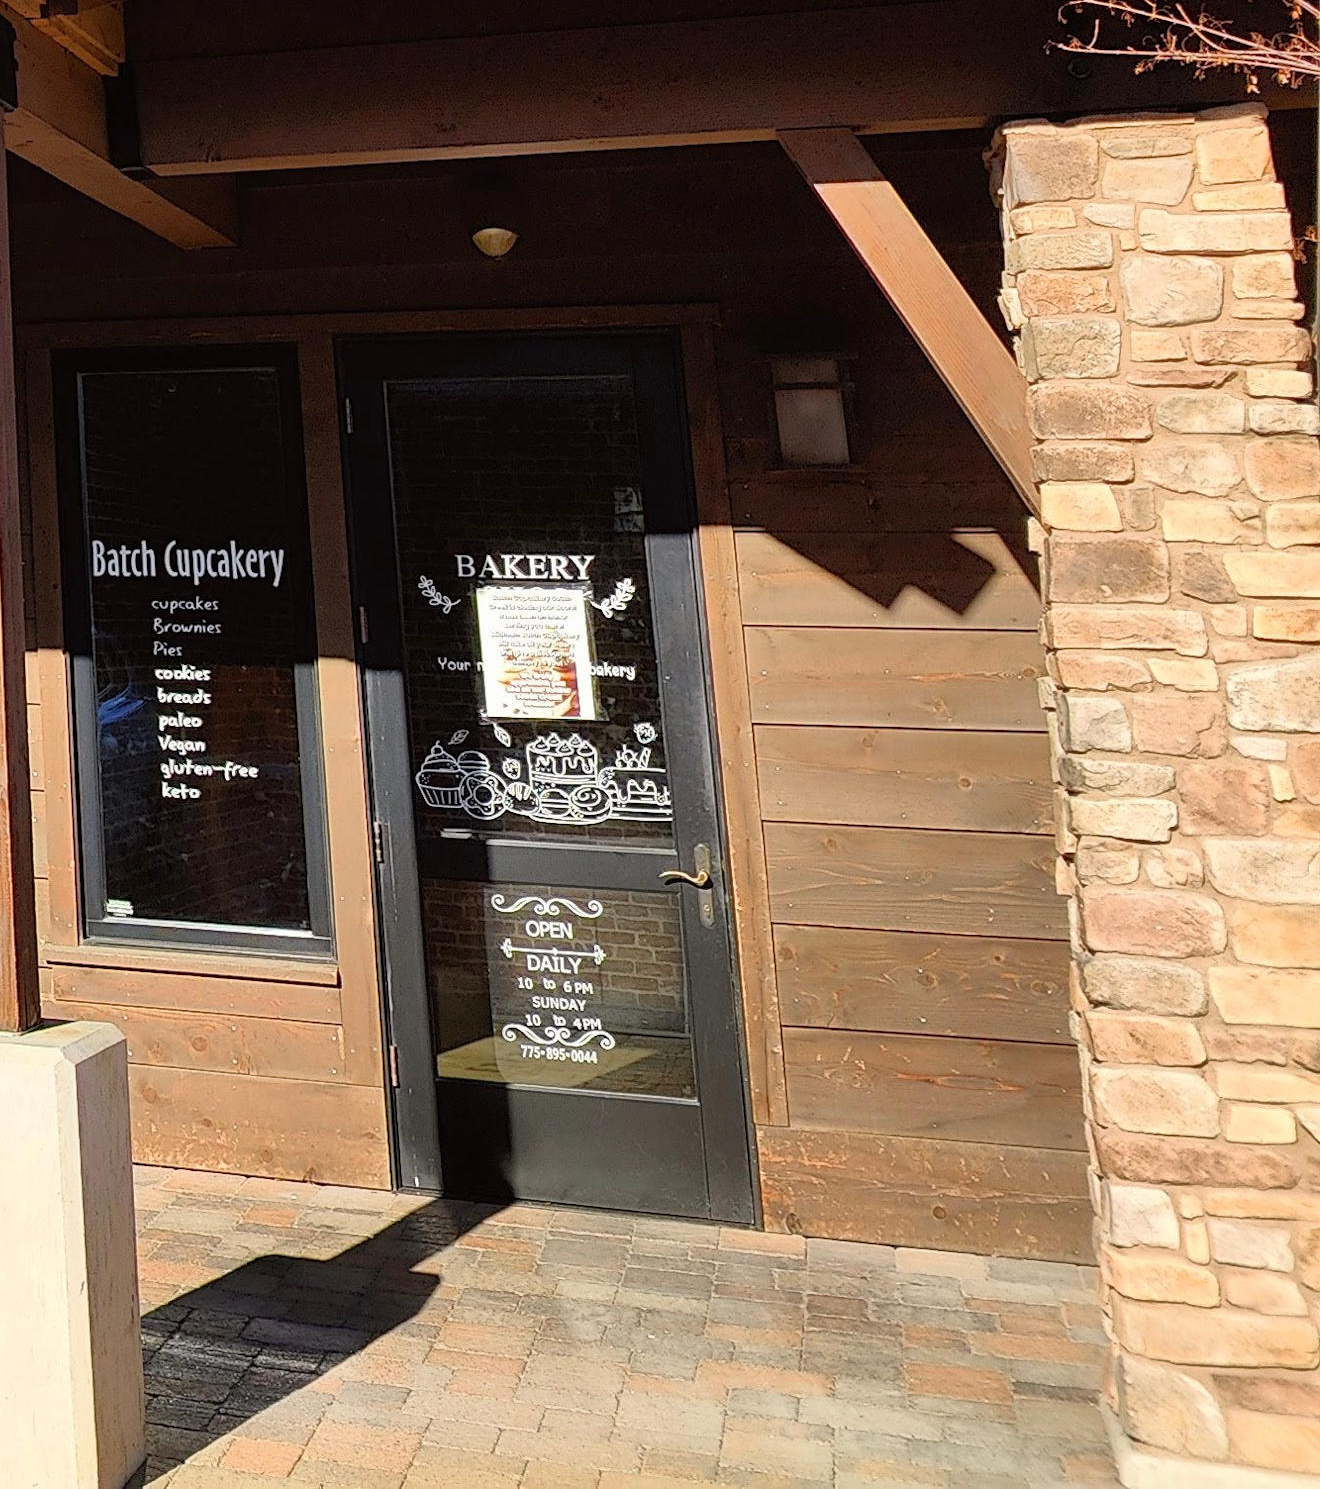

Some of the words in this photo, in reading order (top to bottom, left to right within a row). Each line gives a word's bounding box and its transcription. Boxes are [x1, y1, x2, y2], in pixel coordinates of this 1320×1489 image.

[91, 540, 157, 578] Batch
[164, 540, 285, 588] Cupcakery
[454, 554, 596, 580] BAKERY
[151, 595, 220, 615] cupcakes
[153, 617, 222, 635] Brownies
[153, 641, 183, 656] Pies
[154, 664, 211, 681] cookies
[437, 657, 472, 672] Your
[156, 686, 212, 704] breads
[157, 711, 203, 731] paleo
[157, 734, 206, 755] Vegan
[160, 758, 260, 781] gluten-free
[161, 781, 201, 800] keto
[525, 920, 574, 939] OPEN
[526, 954, 583, 974] DAILY
[517, 976, 533, 990] 10
[542, 977, 556, 990] to
[531, 995, 587, 1011] SUNDAY
[524, 1014, 541, 1026] 10
[552, 1014, 566, 1026] to
